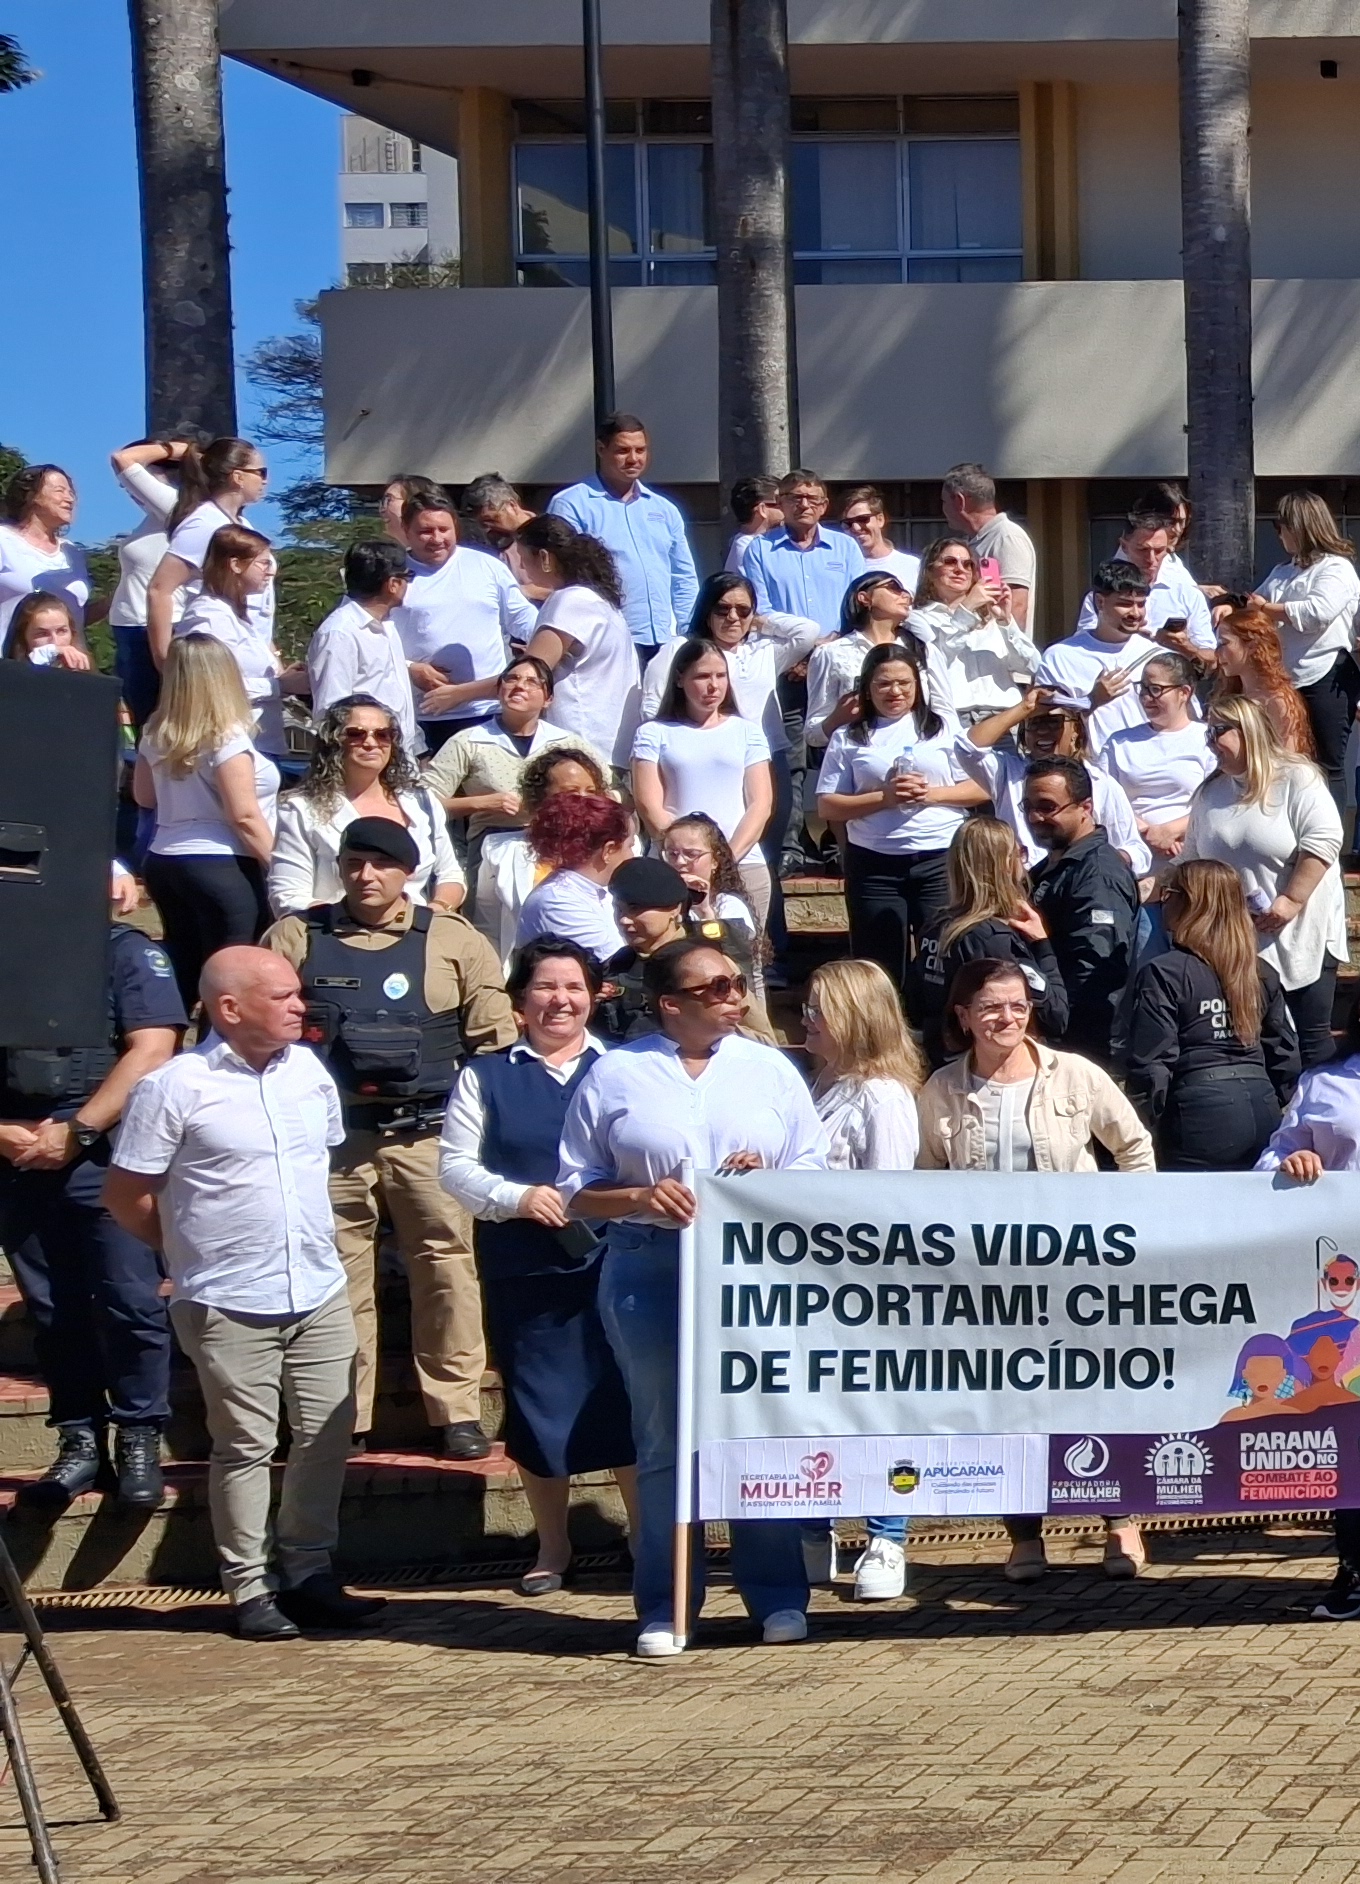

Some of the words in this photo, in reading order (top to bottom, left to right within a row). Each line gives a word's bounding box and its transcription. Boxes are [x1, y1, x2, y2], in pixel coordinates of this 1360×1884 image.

[721, 1221, 956, 1267] NOSSAS
[970, 1223, 1137, 1267] VIDAS
[720, 1283, 1051, 1328] IMPORTAM!
[1065, 1282, 1257, 1326] CHEGA
[720, 1349, 790, 1394] DE
[808, 1338, 1176, 1393] FEMINICÍDIO!
[1240, 1426, 1338, 1451] PARANÁ
[1240, 1451, 1316, 1470] UNIDO
[1316, 1453, 1338, 1465] NO
[923, 1465, 1005, 1478] APUCARANA
[1245, 1473, 1312, 1484] COMBATE
[1314, 1472, 1333, 1483] AO
[741, 1481, 843, 1499] MULHER
[1051, 1487, 1069, 1498] DA
[1070, 1487, 1121, 1498] MULHER
[1156, 1484, 1203, 1494] MULHER
[1240, 1484, 1338, 1500] FEMINICÍDIO
